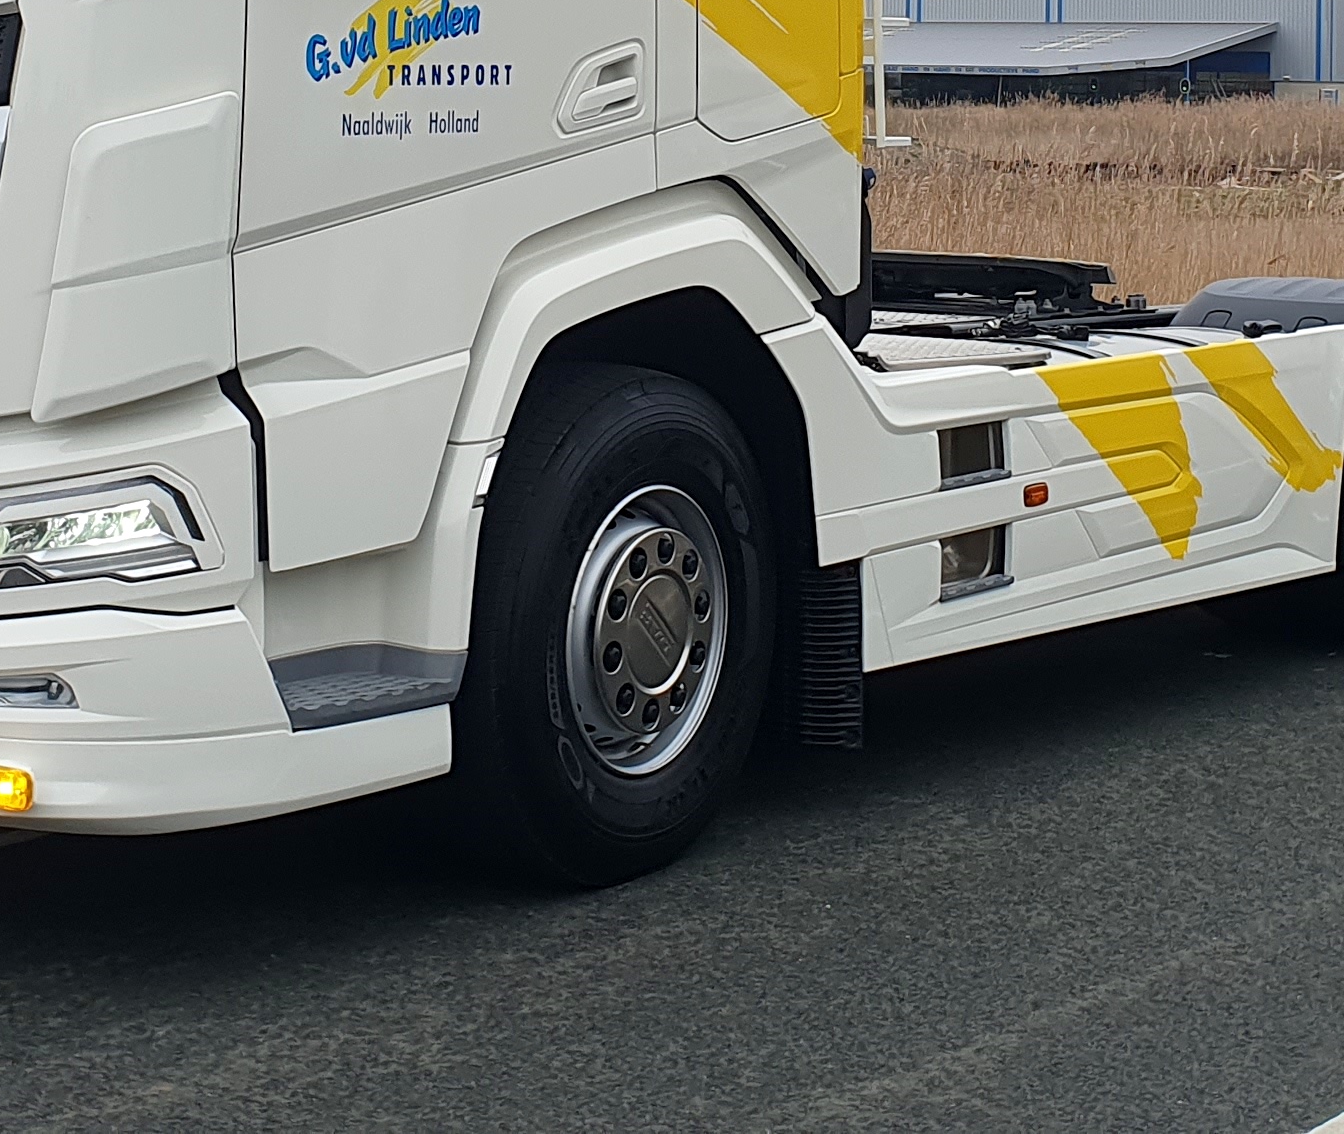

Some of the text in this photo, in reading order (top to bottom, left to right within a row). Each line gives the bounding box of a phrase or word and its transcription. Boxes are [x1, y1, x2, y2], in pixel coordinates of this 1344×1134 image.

[387, 65, 512, 86] TRANSPORT
[342, 110, 479, 140] Naaldwijk Holland
